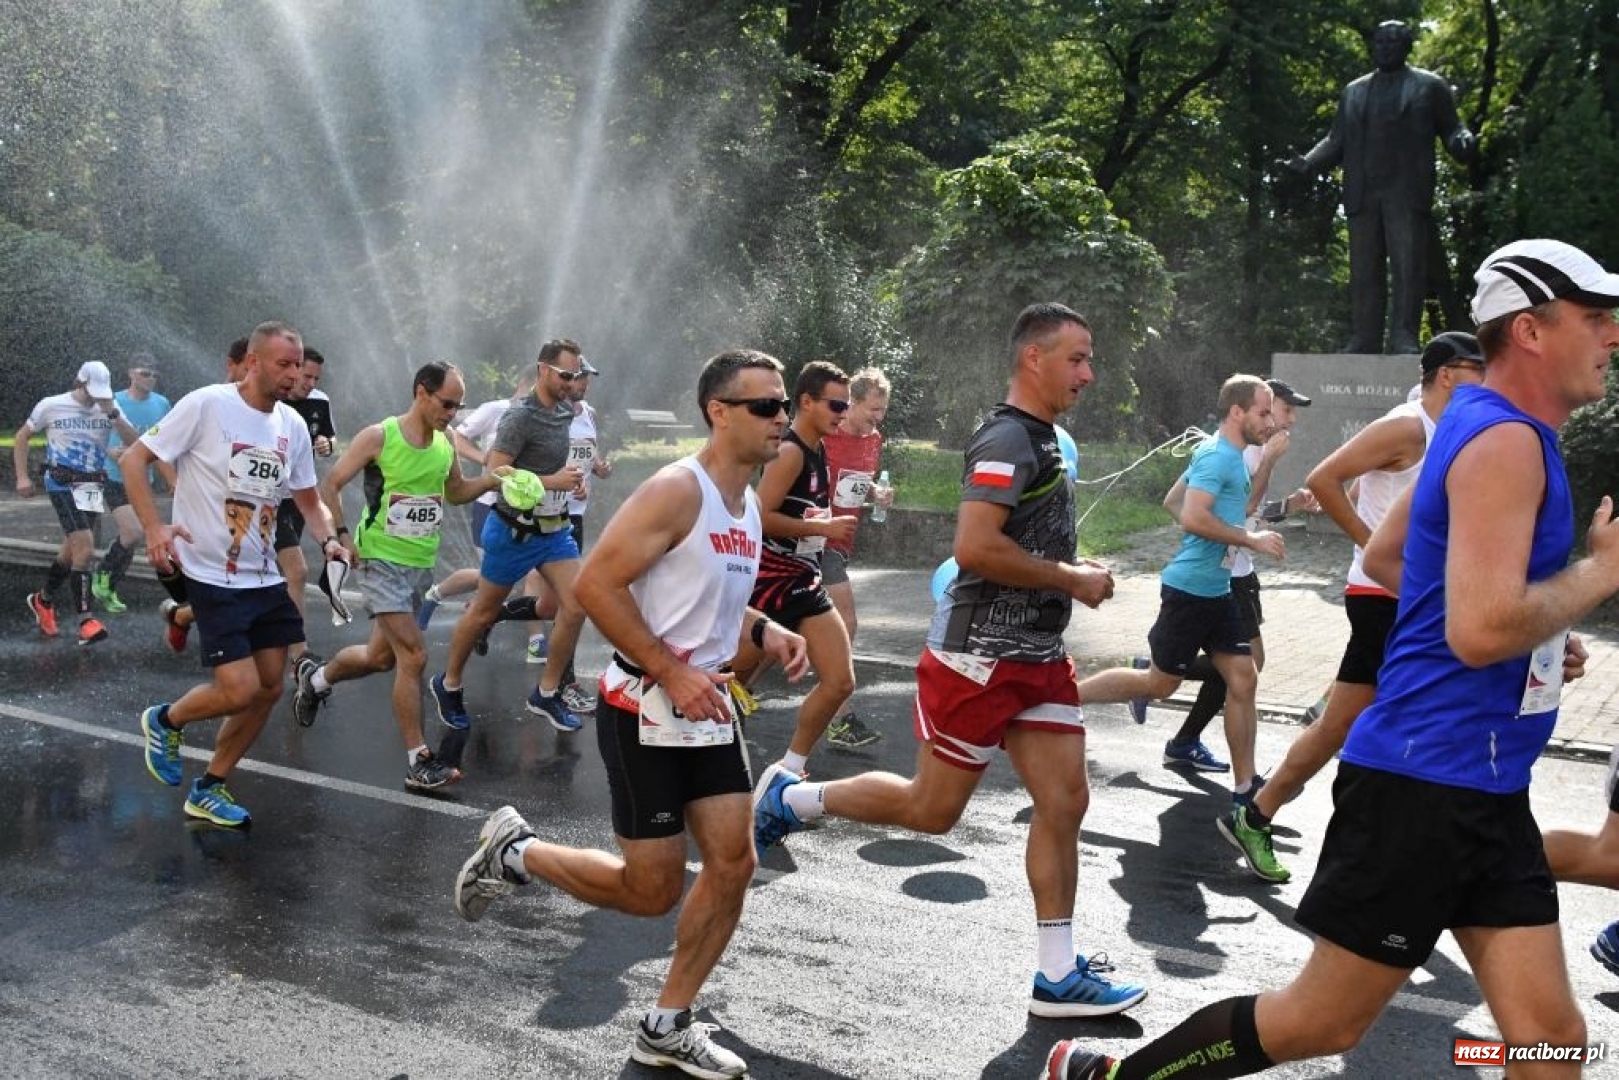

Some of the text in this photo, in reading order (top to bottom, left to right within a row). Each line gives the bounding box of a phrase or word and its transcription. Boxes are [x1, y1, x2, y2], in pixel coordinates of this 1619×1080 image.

[571, 446, 592, 460] 786
[247, 459, 279, 482] 284
[405, 507, 437, 523] 485
